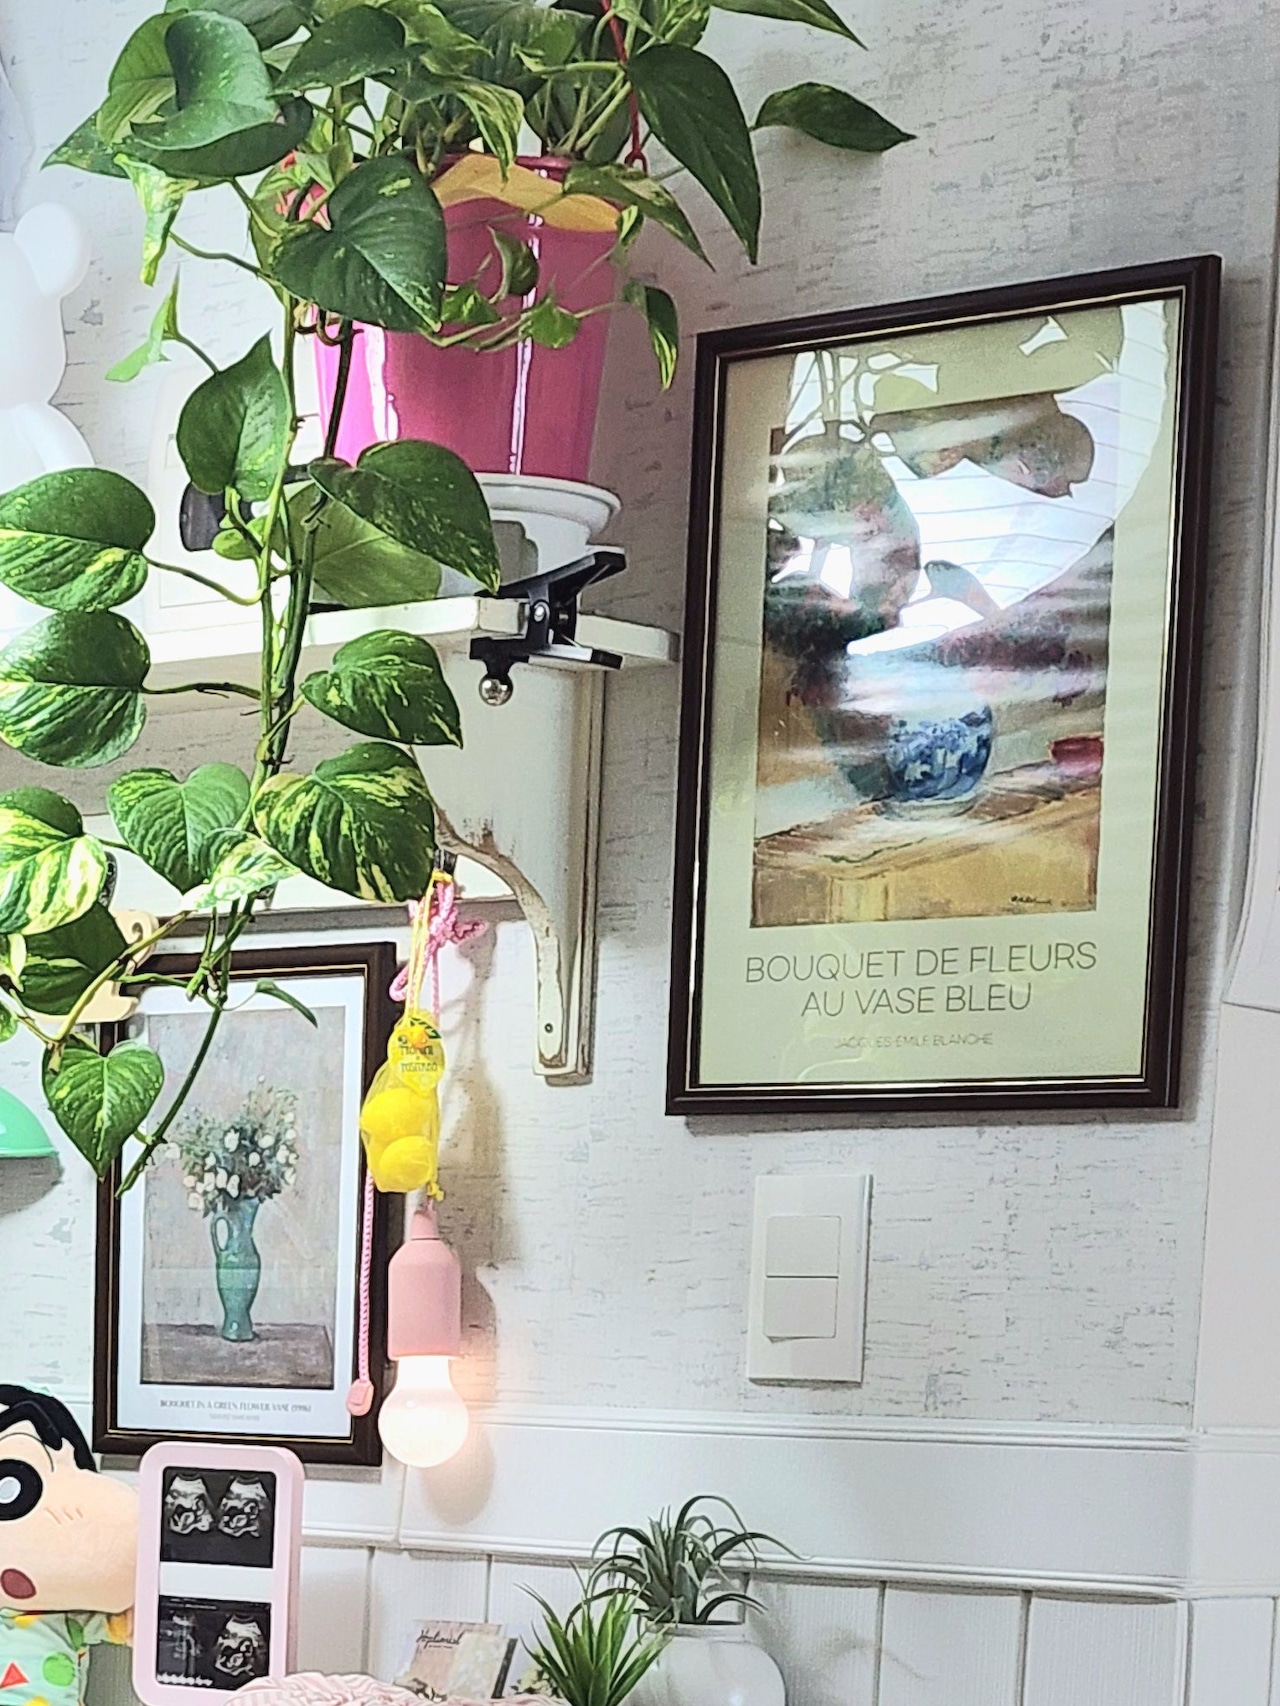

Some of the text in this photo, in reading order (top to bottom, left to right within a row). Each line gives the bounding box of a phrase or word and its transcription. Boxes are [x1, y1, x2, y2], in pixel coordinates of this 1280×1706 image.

[745, 942, 1098, 984] BOUQUET DE FLEURS
[801, 983, 1032, 1017] AU VASE BLEU
